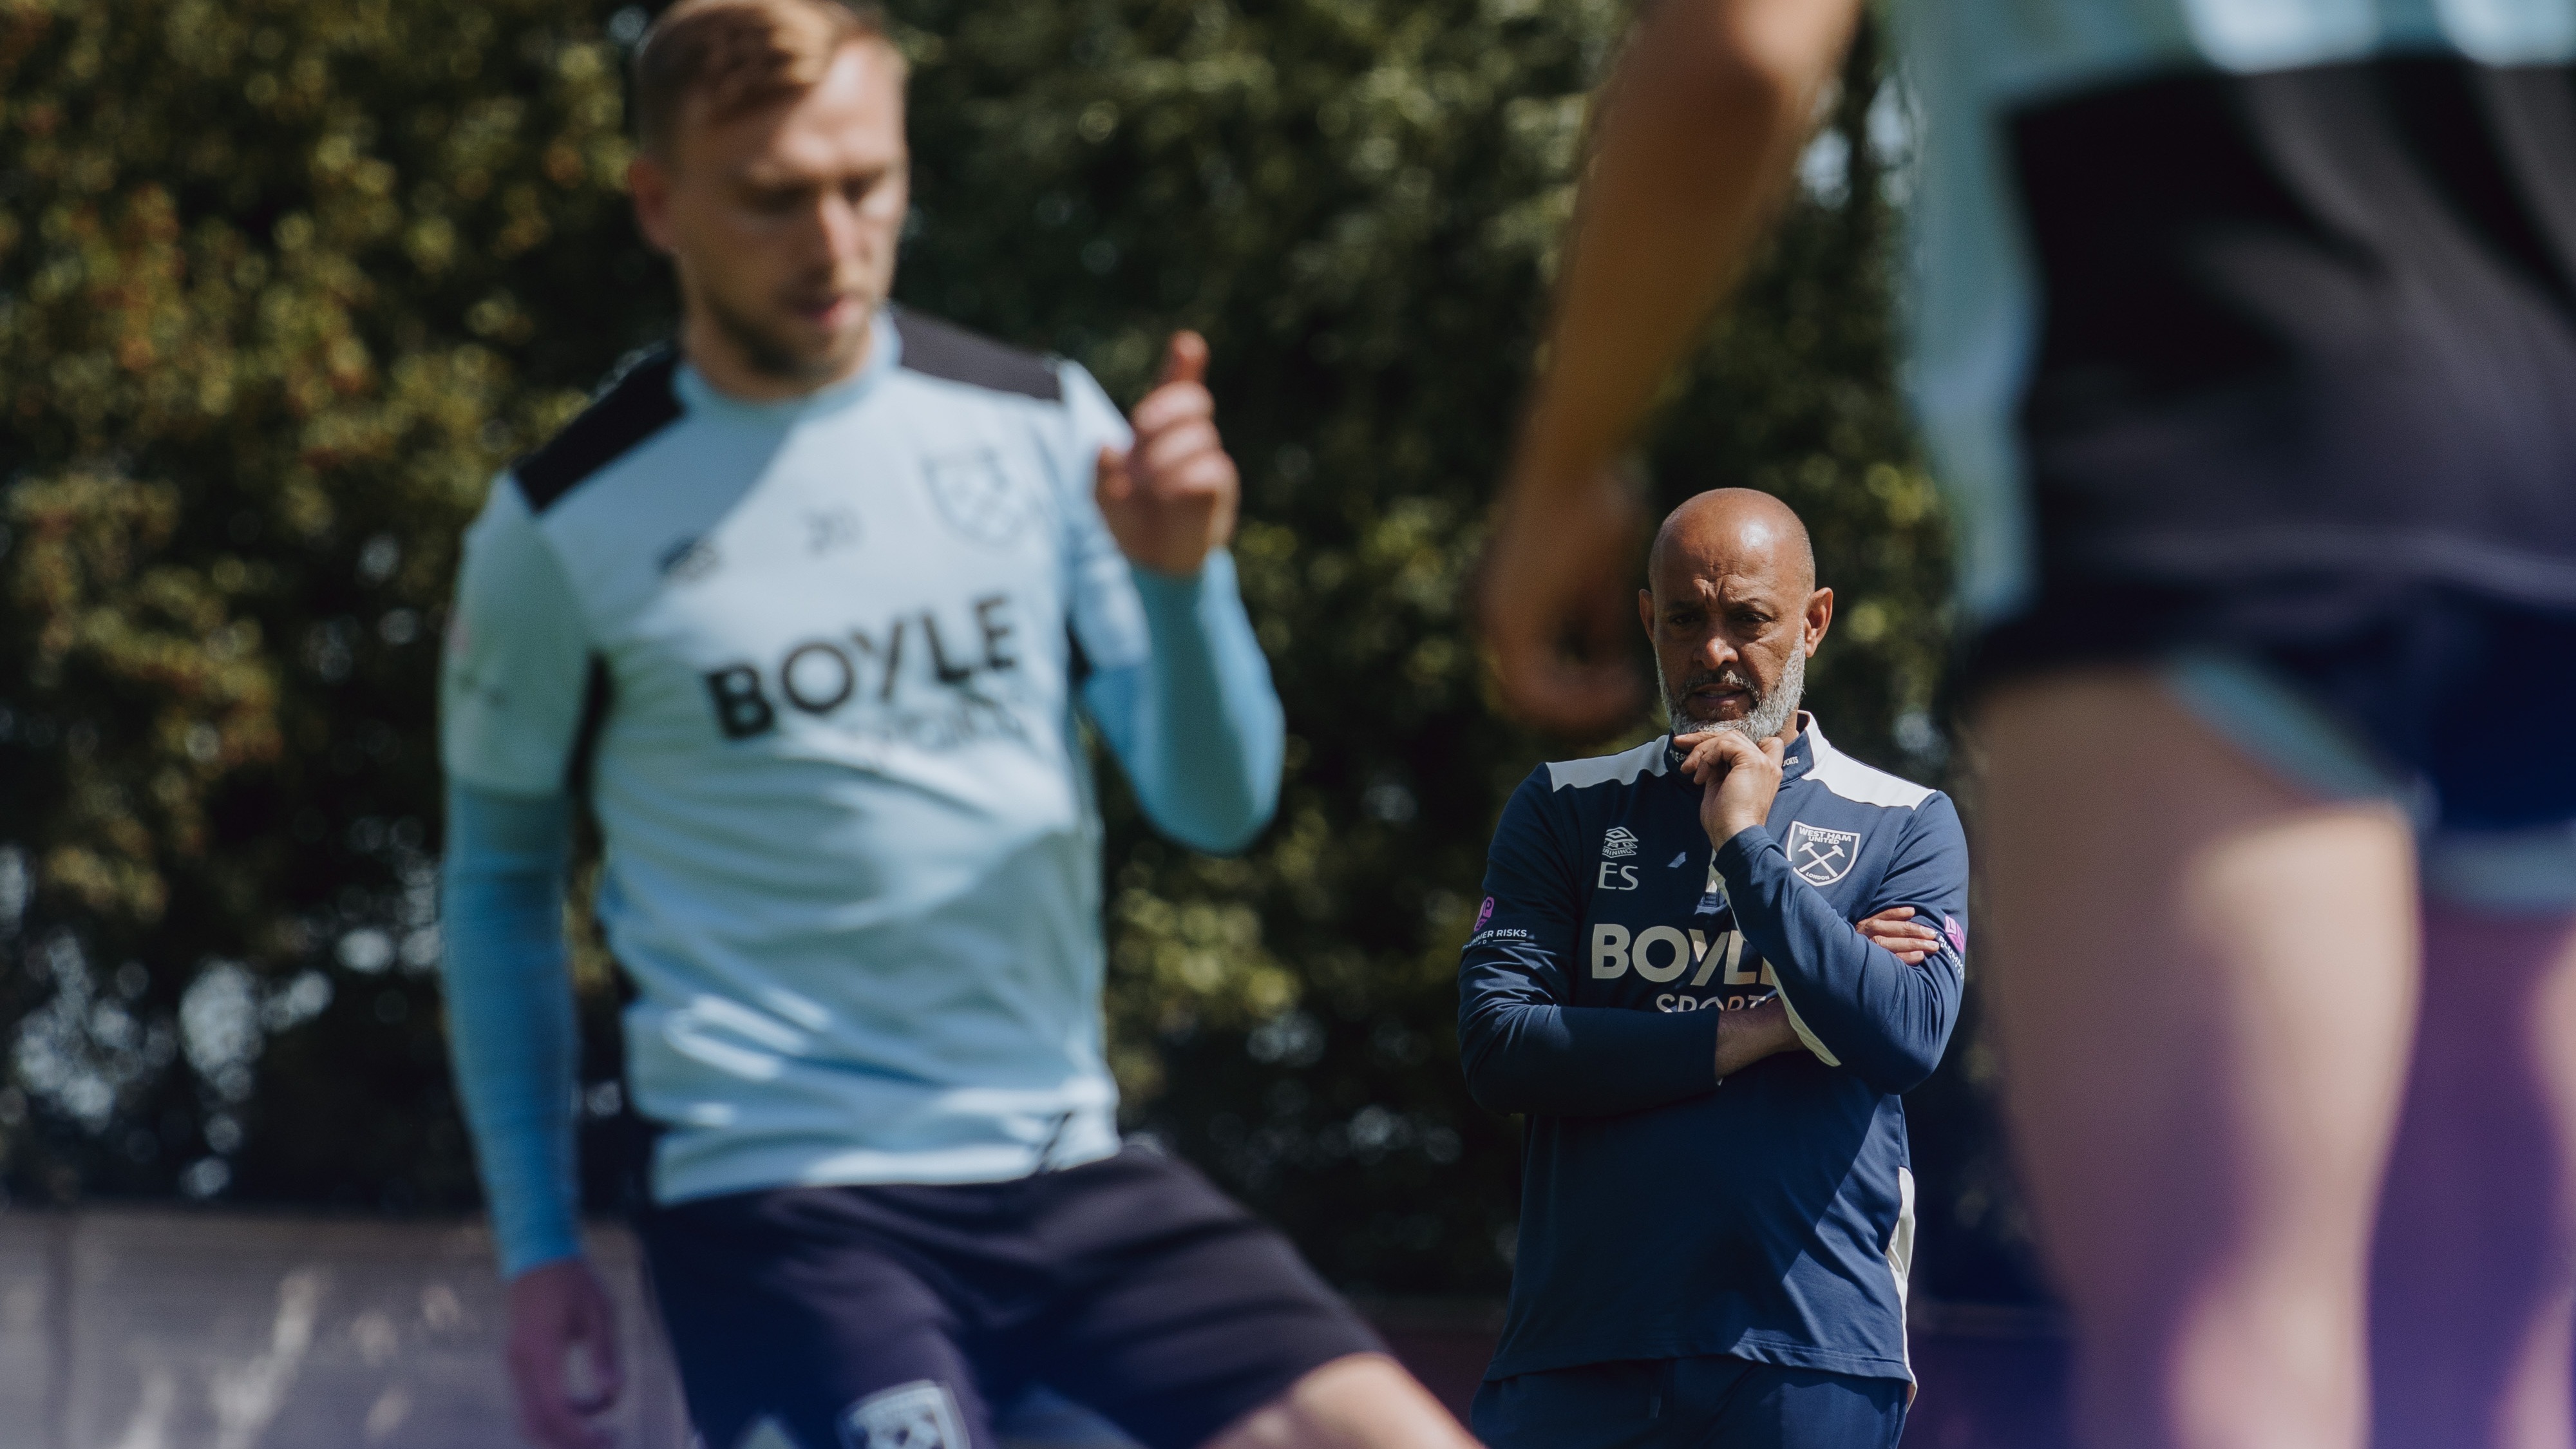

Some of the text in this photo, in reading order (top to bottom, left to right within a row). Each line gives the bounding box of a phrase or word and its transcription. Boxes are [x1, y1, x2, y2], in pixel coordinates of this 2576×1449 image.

[706, 594, 1016, 741] BOYLE
[1799, 826, 1852, 842] WEST HAM
[1808, 836, 1840, 844] UNITED
[1598, 861, 1639, 891] ES
[1805, 871, 1830, 880] LONDON
[1496, 929, 1528, 938] RISKS
